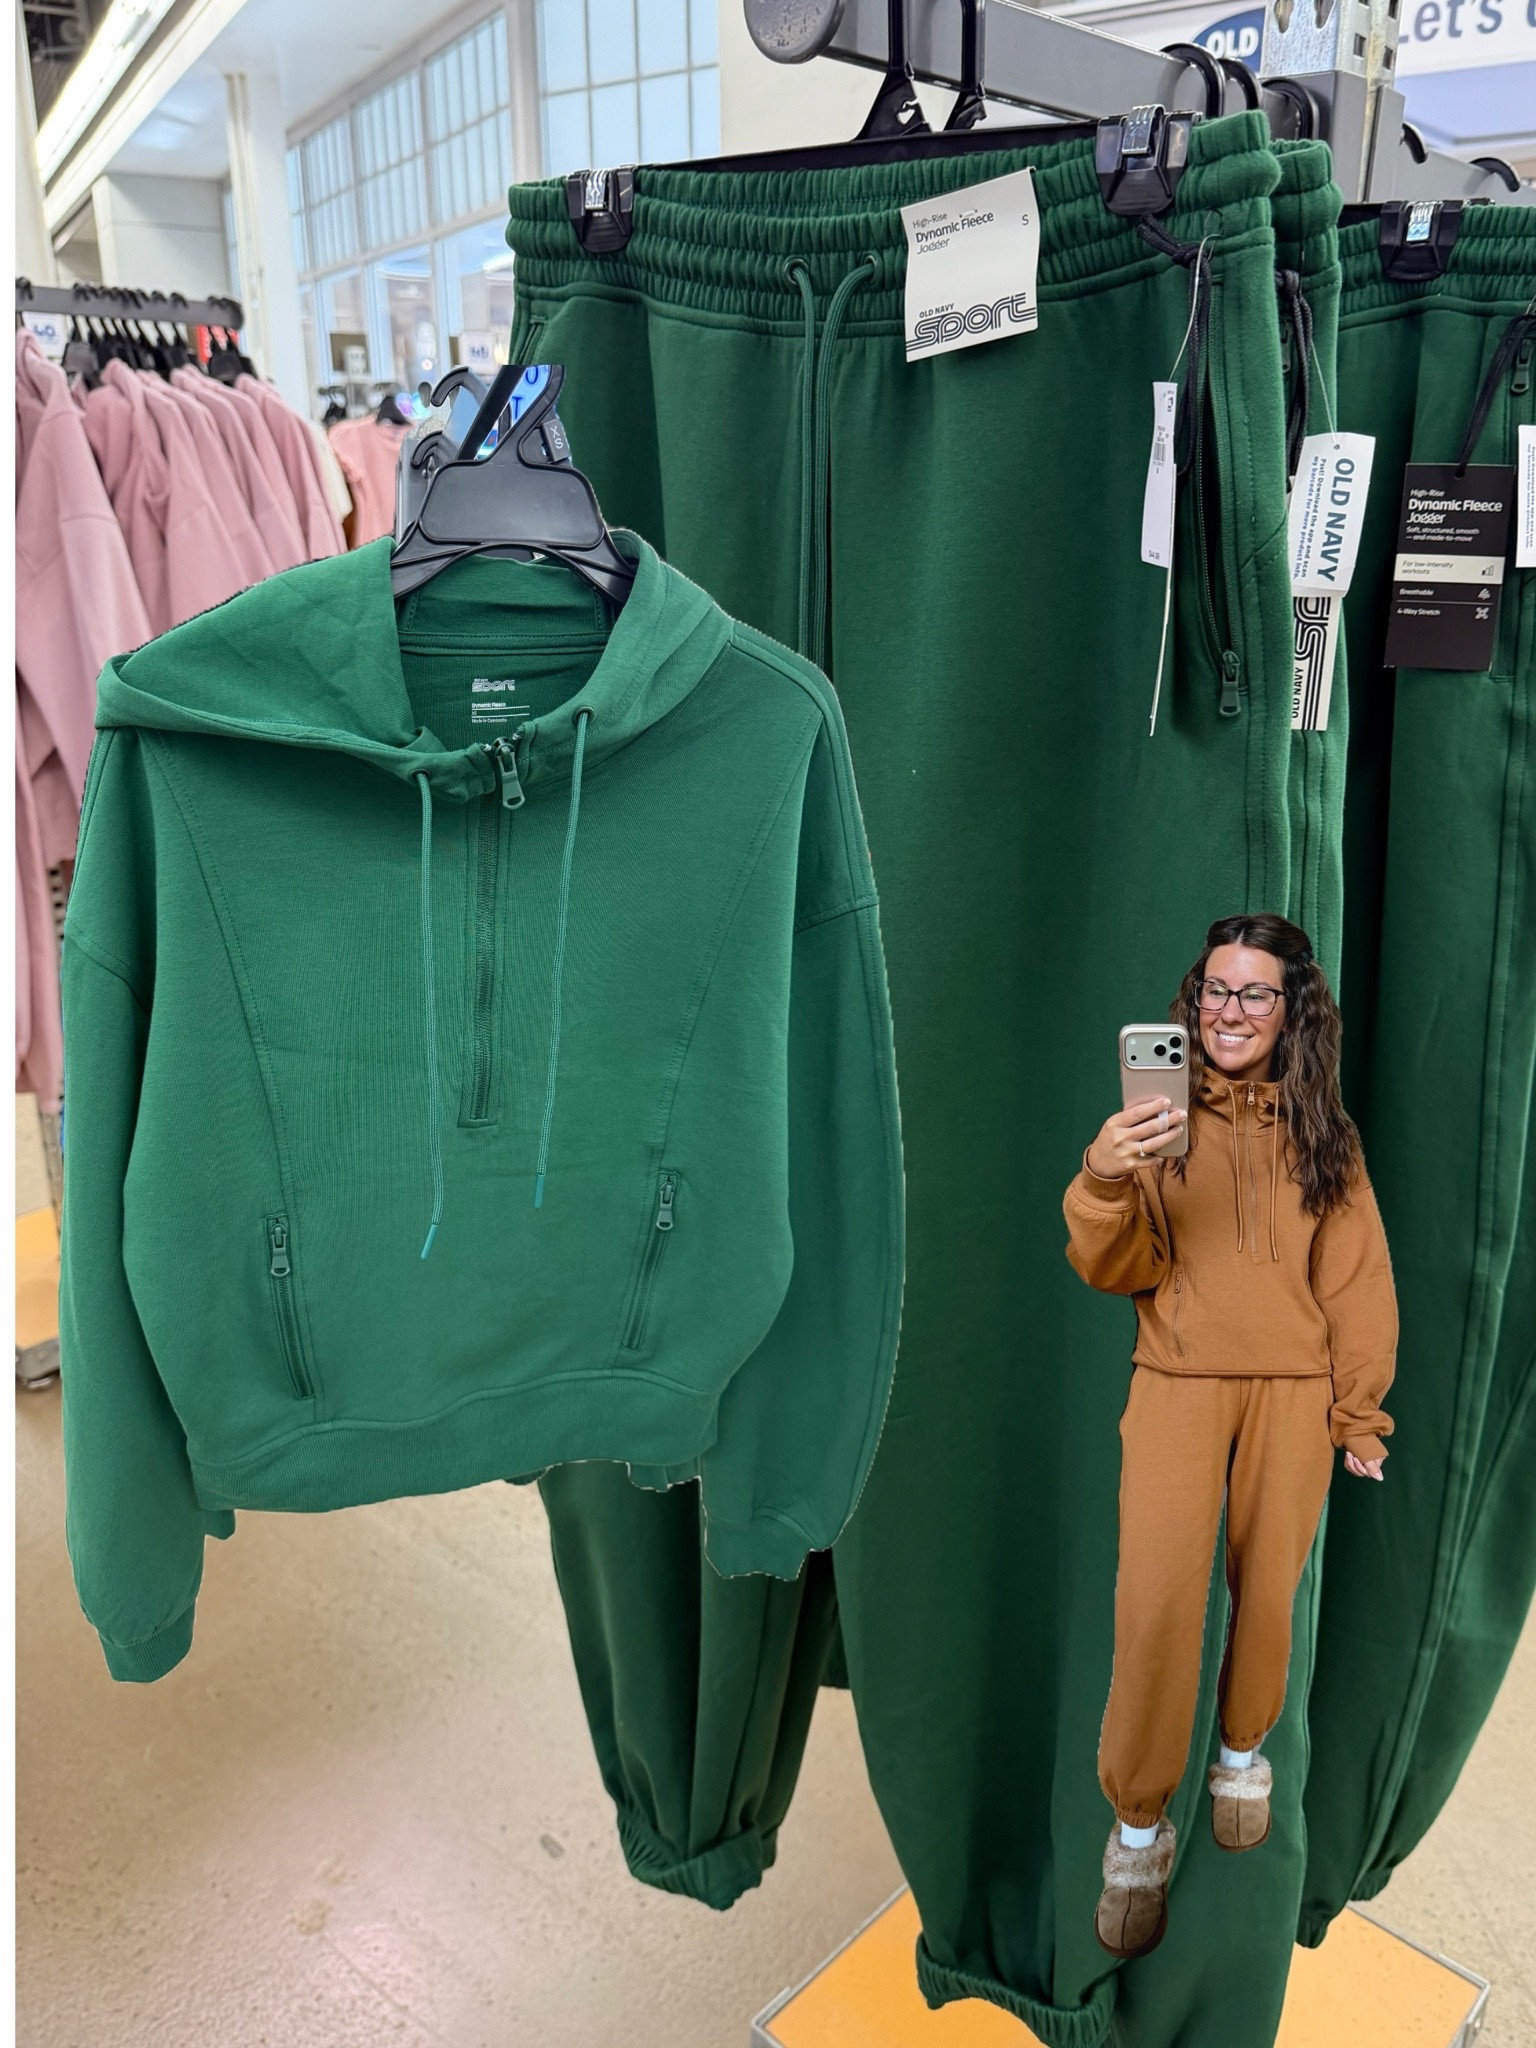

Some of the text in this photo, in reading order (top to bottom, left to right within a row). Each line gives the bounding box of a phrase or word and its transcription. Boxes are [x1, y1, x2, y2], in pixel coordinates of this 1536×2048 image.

[1206, 26, 1259, 59] OLD
[912, 213, 948, 229] High-Rise
[915, 212, 995, 243] Dynamic Fleece
[1021, 214, 1030, 226] S
[917, 238, 951, 255] Jogger
[919, 302, 955, 319] OLD NAVY
[1307, 467, 1318, 496] barcode
[1312, 478, 1322, 514] Download
[1410, 489, 1446, 498] High-Rise
[1408, 499, 1503, 512] Dynamic Fleece
[1302, 511, 1310, 531] more
[1309, 514, 1318, 527] the
[1317, 458, 1355, 582] OLD NAVY
[1406, 512, 1447, 524] Jogger
[1297, 531, 1307, 562] product
[1304, 544, 1312, 559] and
[1301, 560, 1309, 578] scan
[1294, 667, 1304, 696] NAVY
